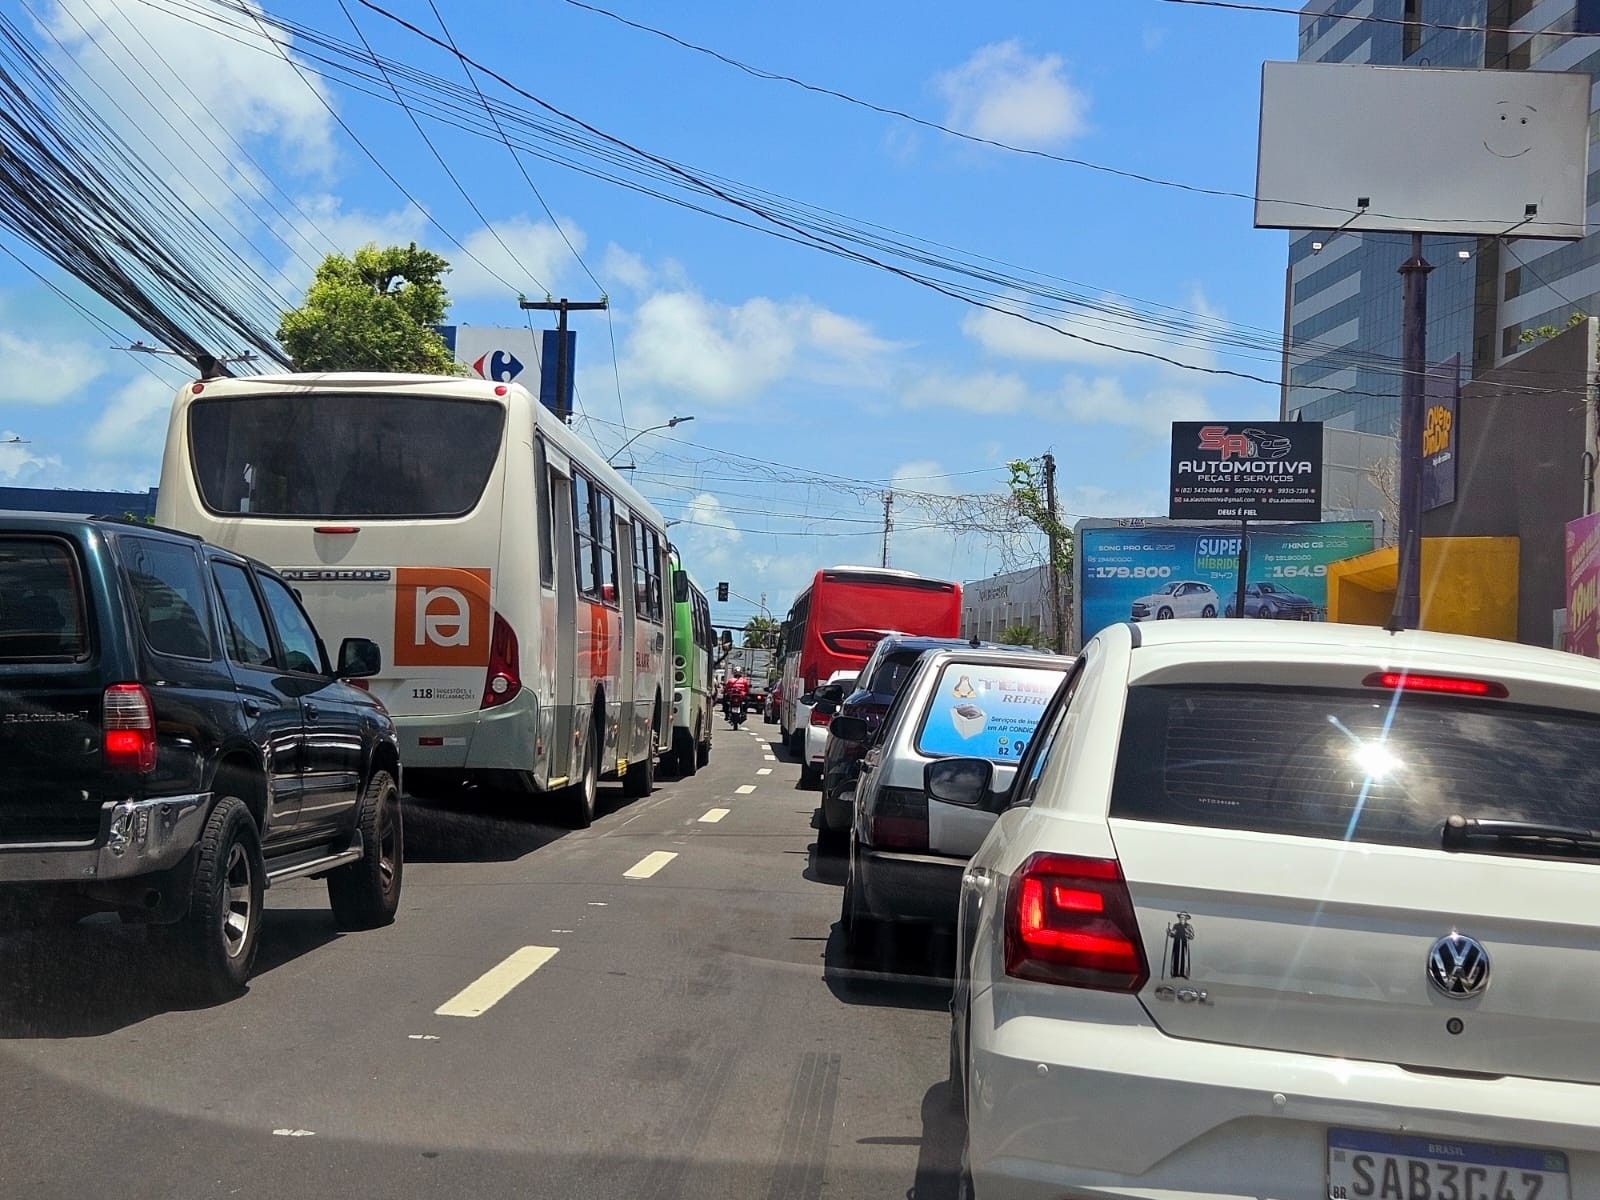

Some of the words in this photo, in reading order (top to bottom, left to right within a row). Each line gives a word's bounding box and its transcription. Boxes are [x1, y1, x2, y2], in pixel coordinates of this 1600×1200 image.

[1198, 426, 1248, 460] SA
[1178, 460, 1312, 474] AUTOMOTIVA
[1197, 474, 1231, 483] PEÇAS
[1243, 475, 1294, 483] SERVIÇOS
[1237, 507, 1242, 516] É
[1311, 541, 1324, 549] GS
[1096, 566, 1171, 578] 179.800
[412, 688, 433, 699] 118
[991, 716, 1017, 724] Serviços
[998, 747, 1009, 755] 82
[1155, 985, 1214, 1005] GOL
[1428, 1143, 1465, 1156] BRASIL
[1333, 1185, 1347, 1199] BR
